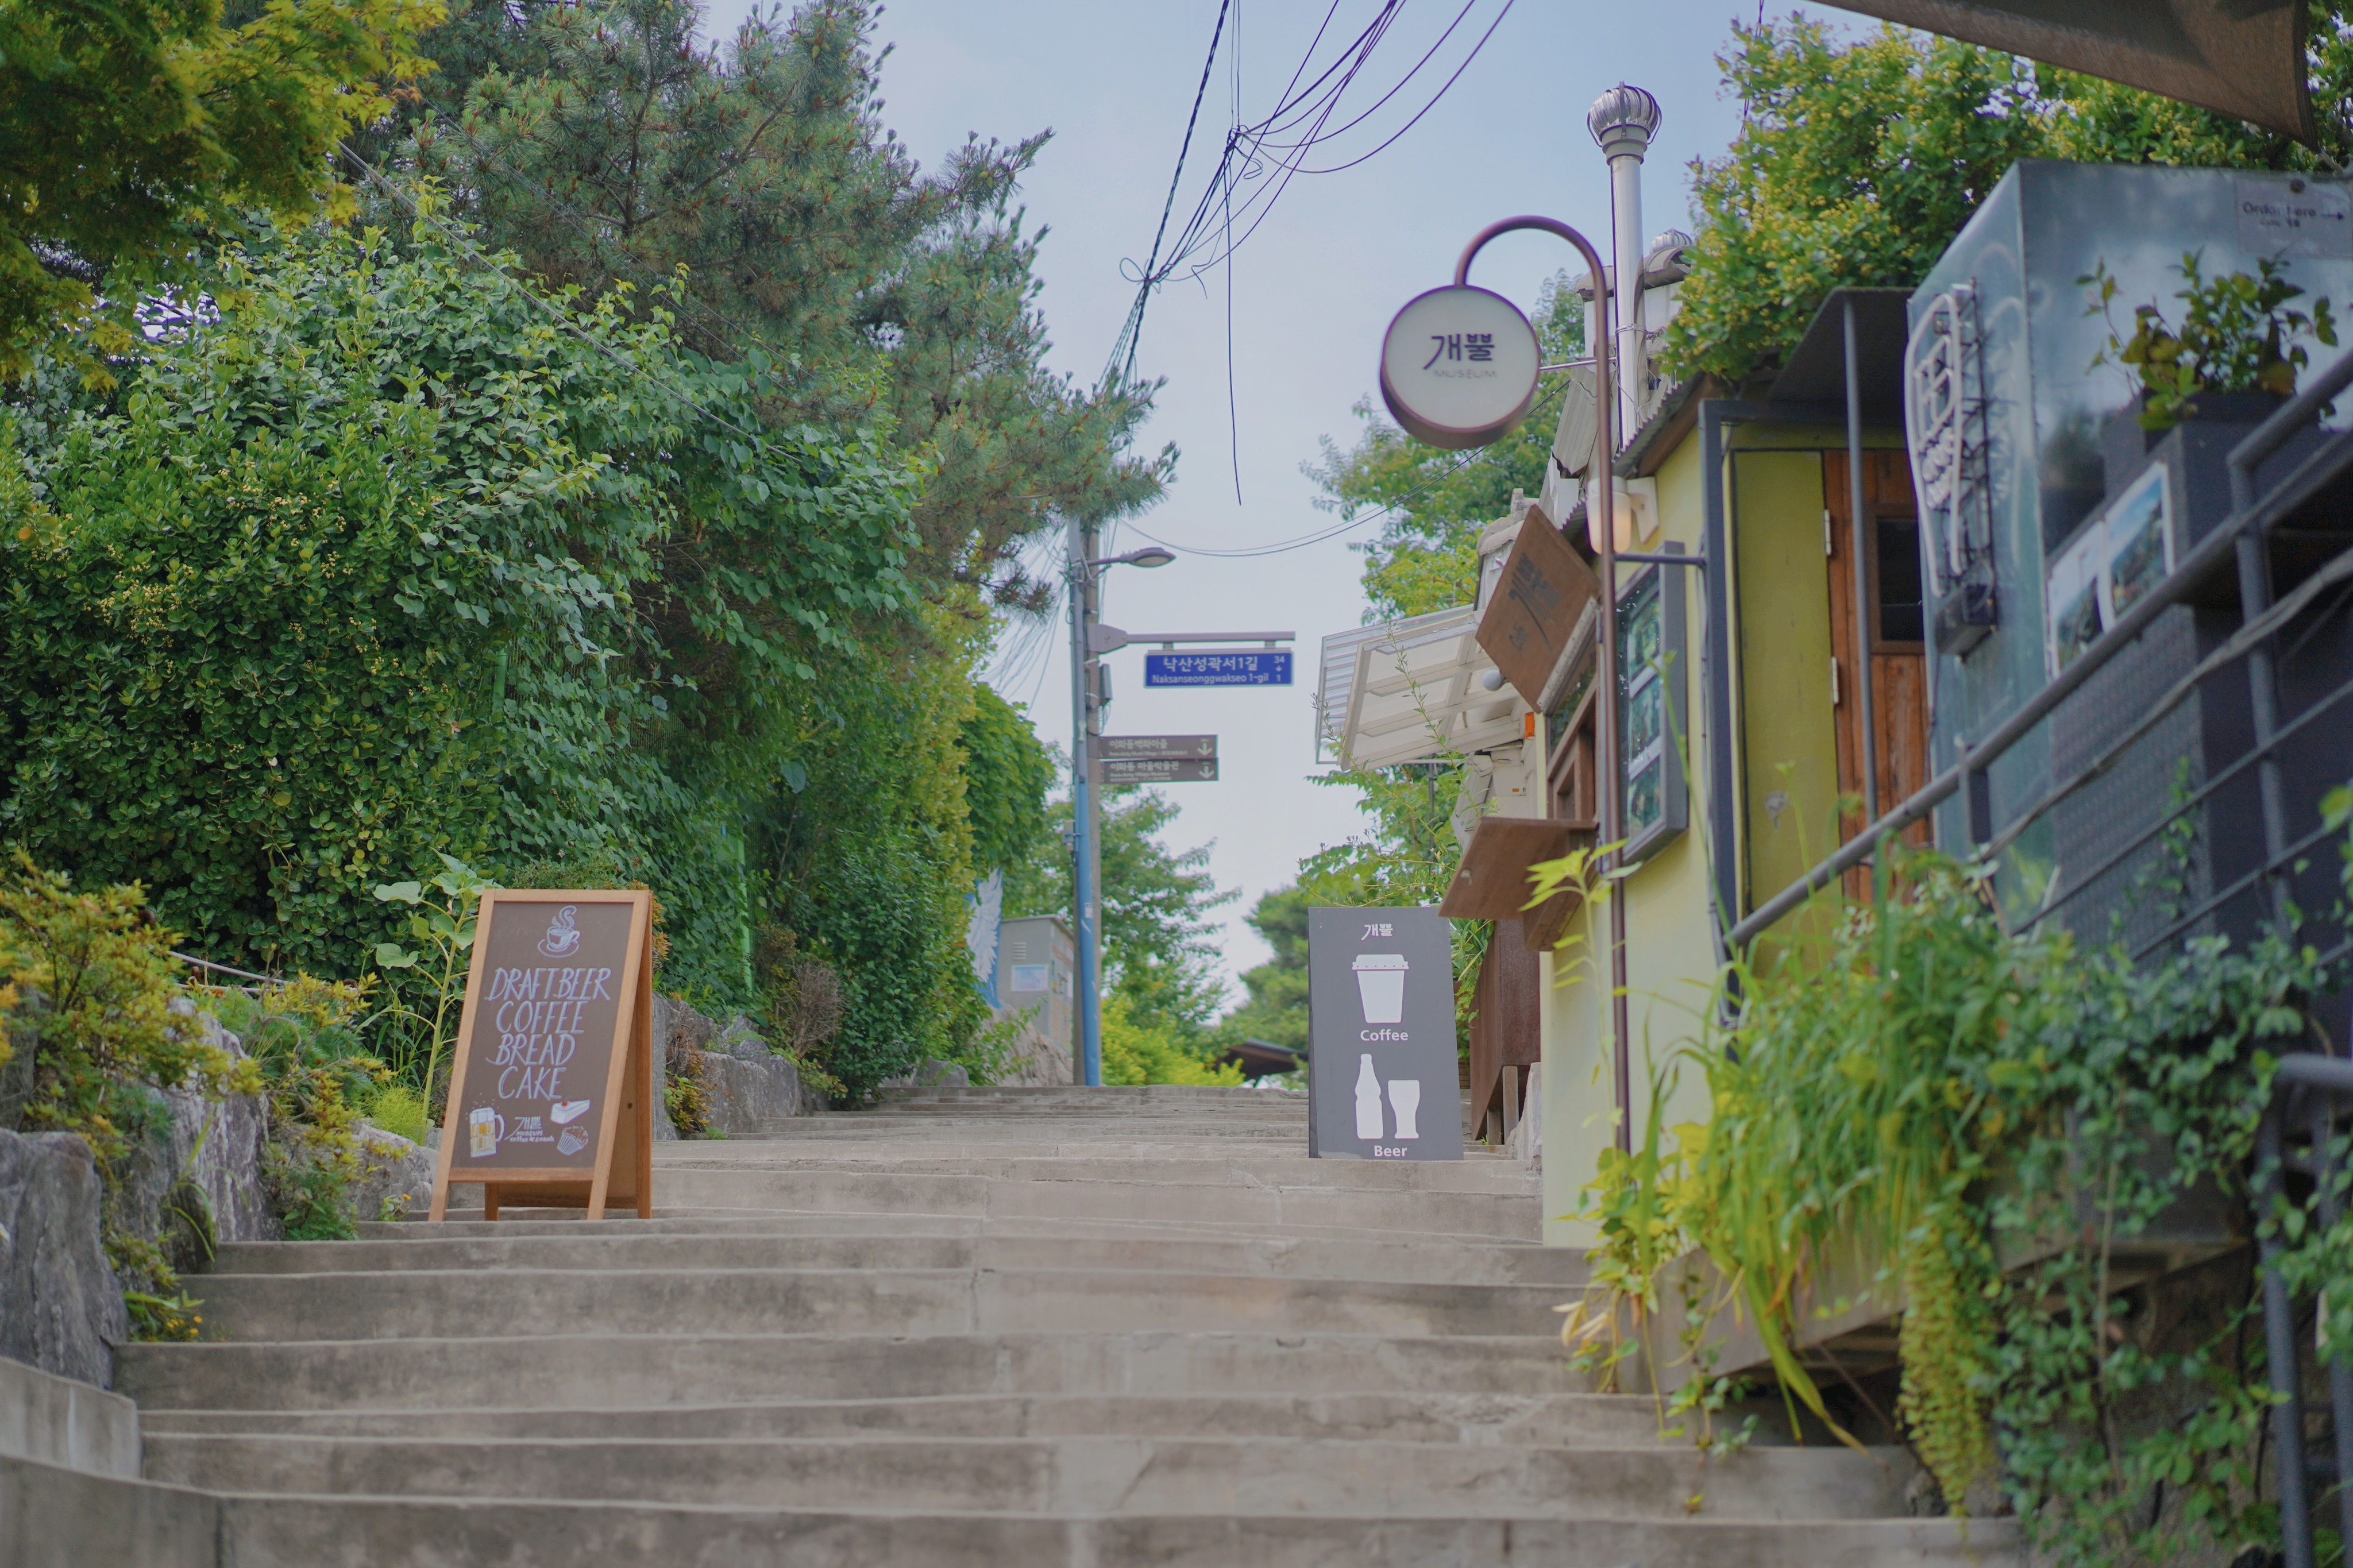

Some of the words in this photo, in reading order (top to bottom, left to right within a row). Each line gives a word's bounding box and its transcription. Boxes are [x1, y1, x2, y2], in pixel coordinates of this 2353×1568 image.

[1423, 333, 1494, 369] 개뿔
[1434, 369, 1498, 379] MUSEUM
[1163, 656, 1257, 672] 낙산성곽서1길
[1274, 656, 1284, 664] 34
[1152, 673, 1247, 684] Naksanseonggwakseo
[1249, 673, 1269, 683] 1-gil
[1361, 923, 1393, 940] 개뿔
[484, 967, 560, 1001] DRAFT
[553, 967, 612, 1001] BEER
[496, 1000, 589, 1034] COFFEE
[1360, 1029, 1409, 1041] Coffee
[485, 1033, 576, 1065] BREAD
[498, 1065, 567, 1101] CAKE
[504, 1116, 542, 1140] 개뿔
[1374, 1145, 1407, 1157] Beer
